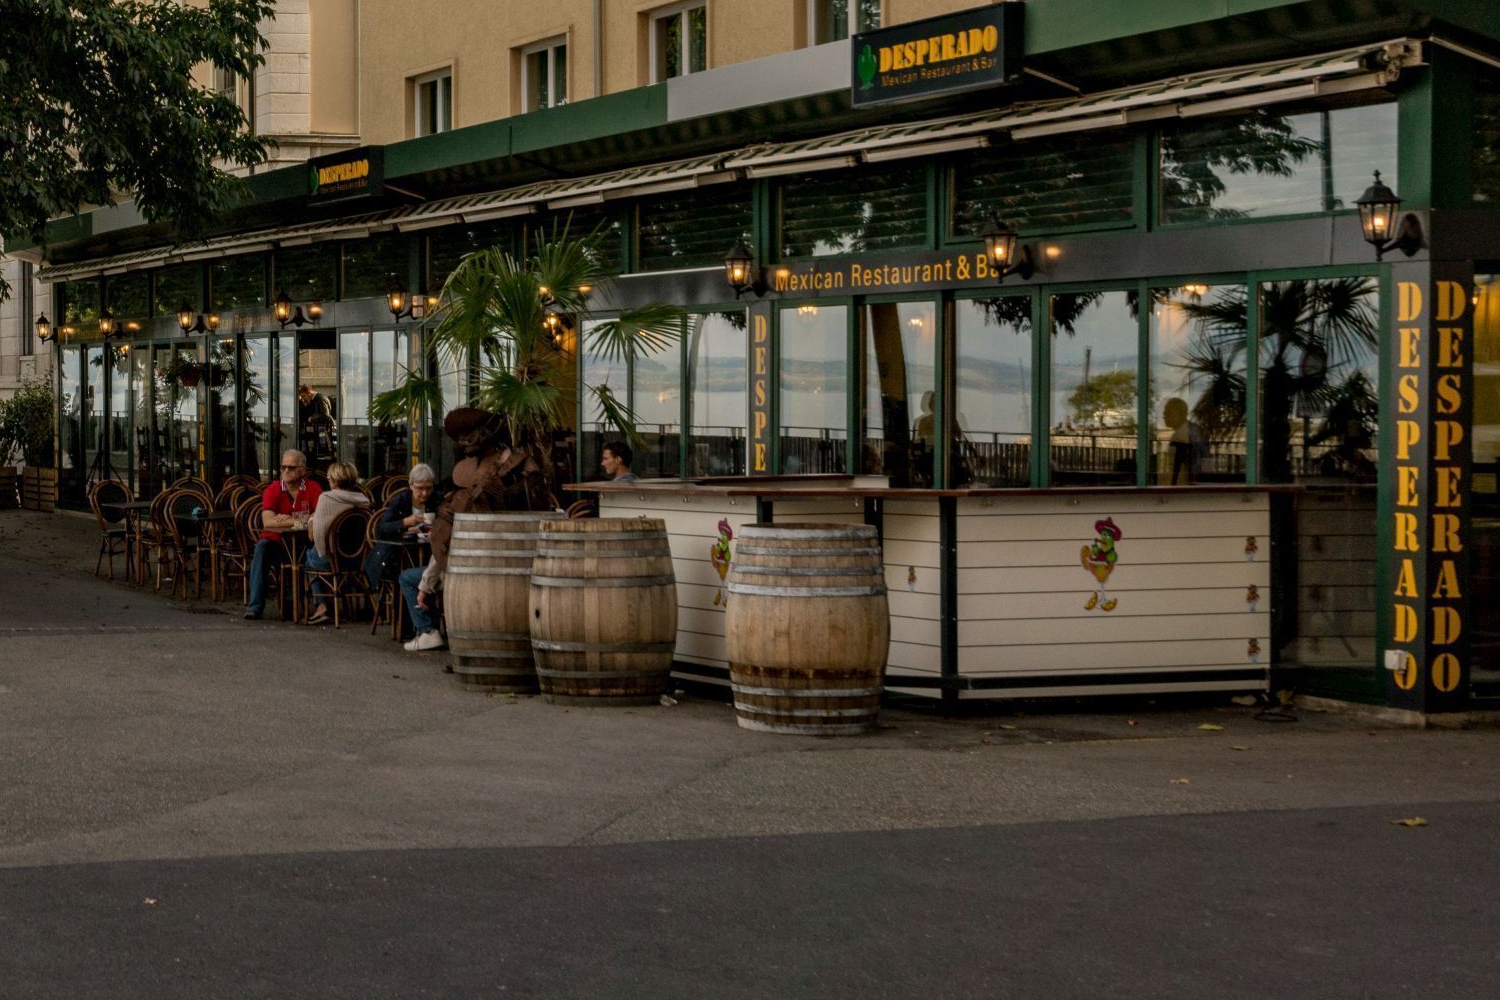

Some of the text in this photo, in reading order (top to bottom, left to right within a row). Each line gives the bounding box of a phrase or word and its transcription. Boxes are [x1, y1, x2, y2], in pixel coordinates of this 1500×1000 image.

[879, 25, 998, 73] DESPERADO
[881, 56, 998, 87] Mexican Restaurant & Bar
[319, 159, 369, 186] DESPERADO
[775, 254, 1010, 293] Mexican Restaurant & Ba
[1393, 281, 1423, 690] DESPERADO
[1431, 280, 1466, 692] DESPERADO
